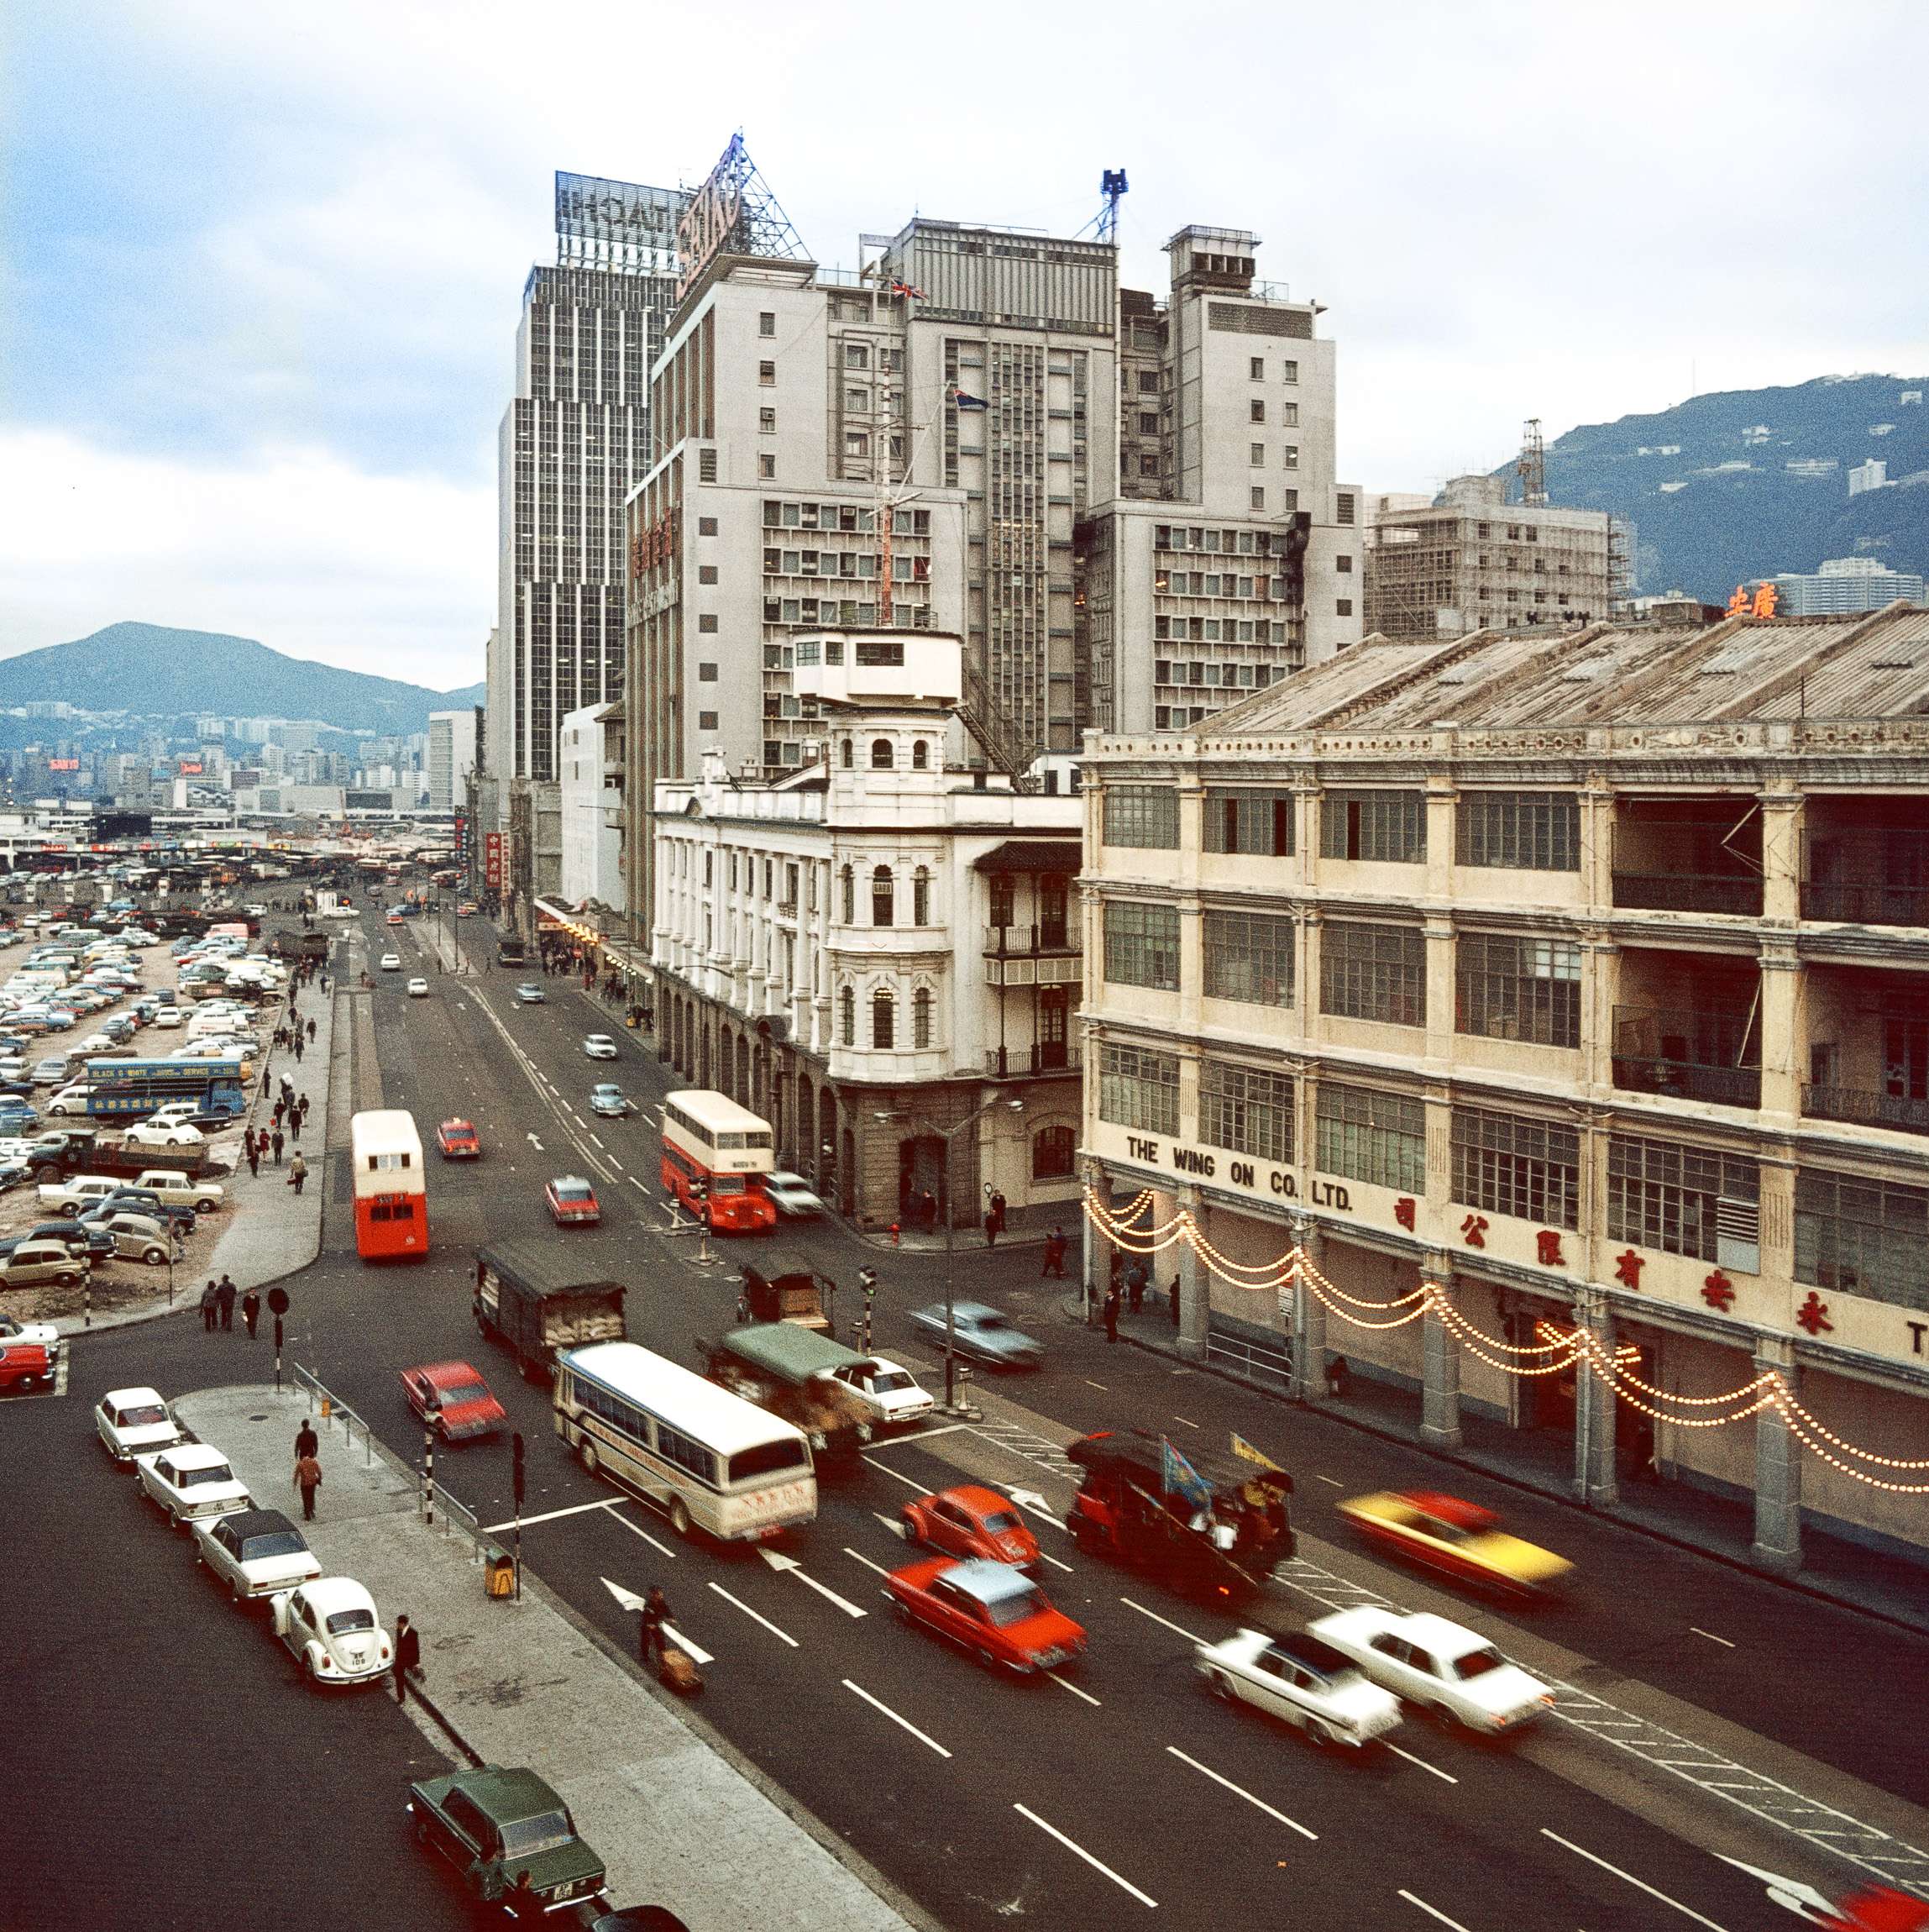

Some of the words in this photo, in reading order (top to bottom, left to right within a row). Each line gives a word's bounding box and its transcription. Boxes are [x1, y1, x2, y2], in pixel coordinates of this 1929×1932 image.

[183, 1068, 209, 1076] SERVICE
[1126, 1137, 1158, 1163] THE
[1173, 1147, 1215, 1177] WING
[1230, 1162, 1255, 1187] ON
[1271, 1172, 1299, 1198] CO.
[1311, 1180, 1353, 1211] LTD.
[1906, 1320, 1928, 1353] T
